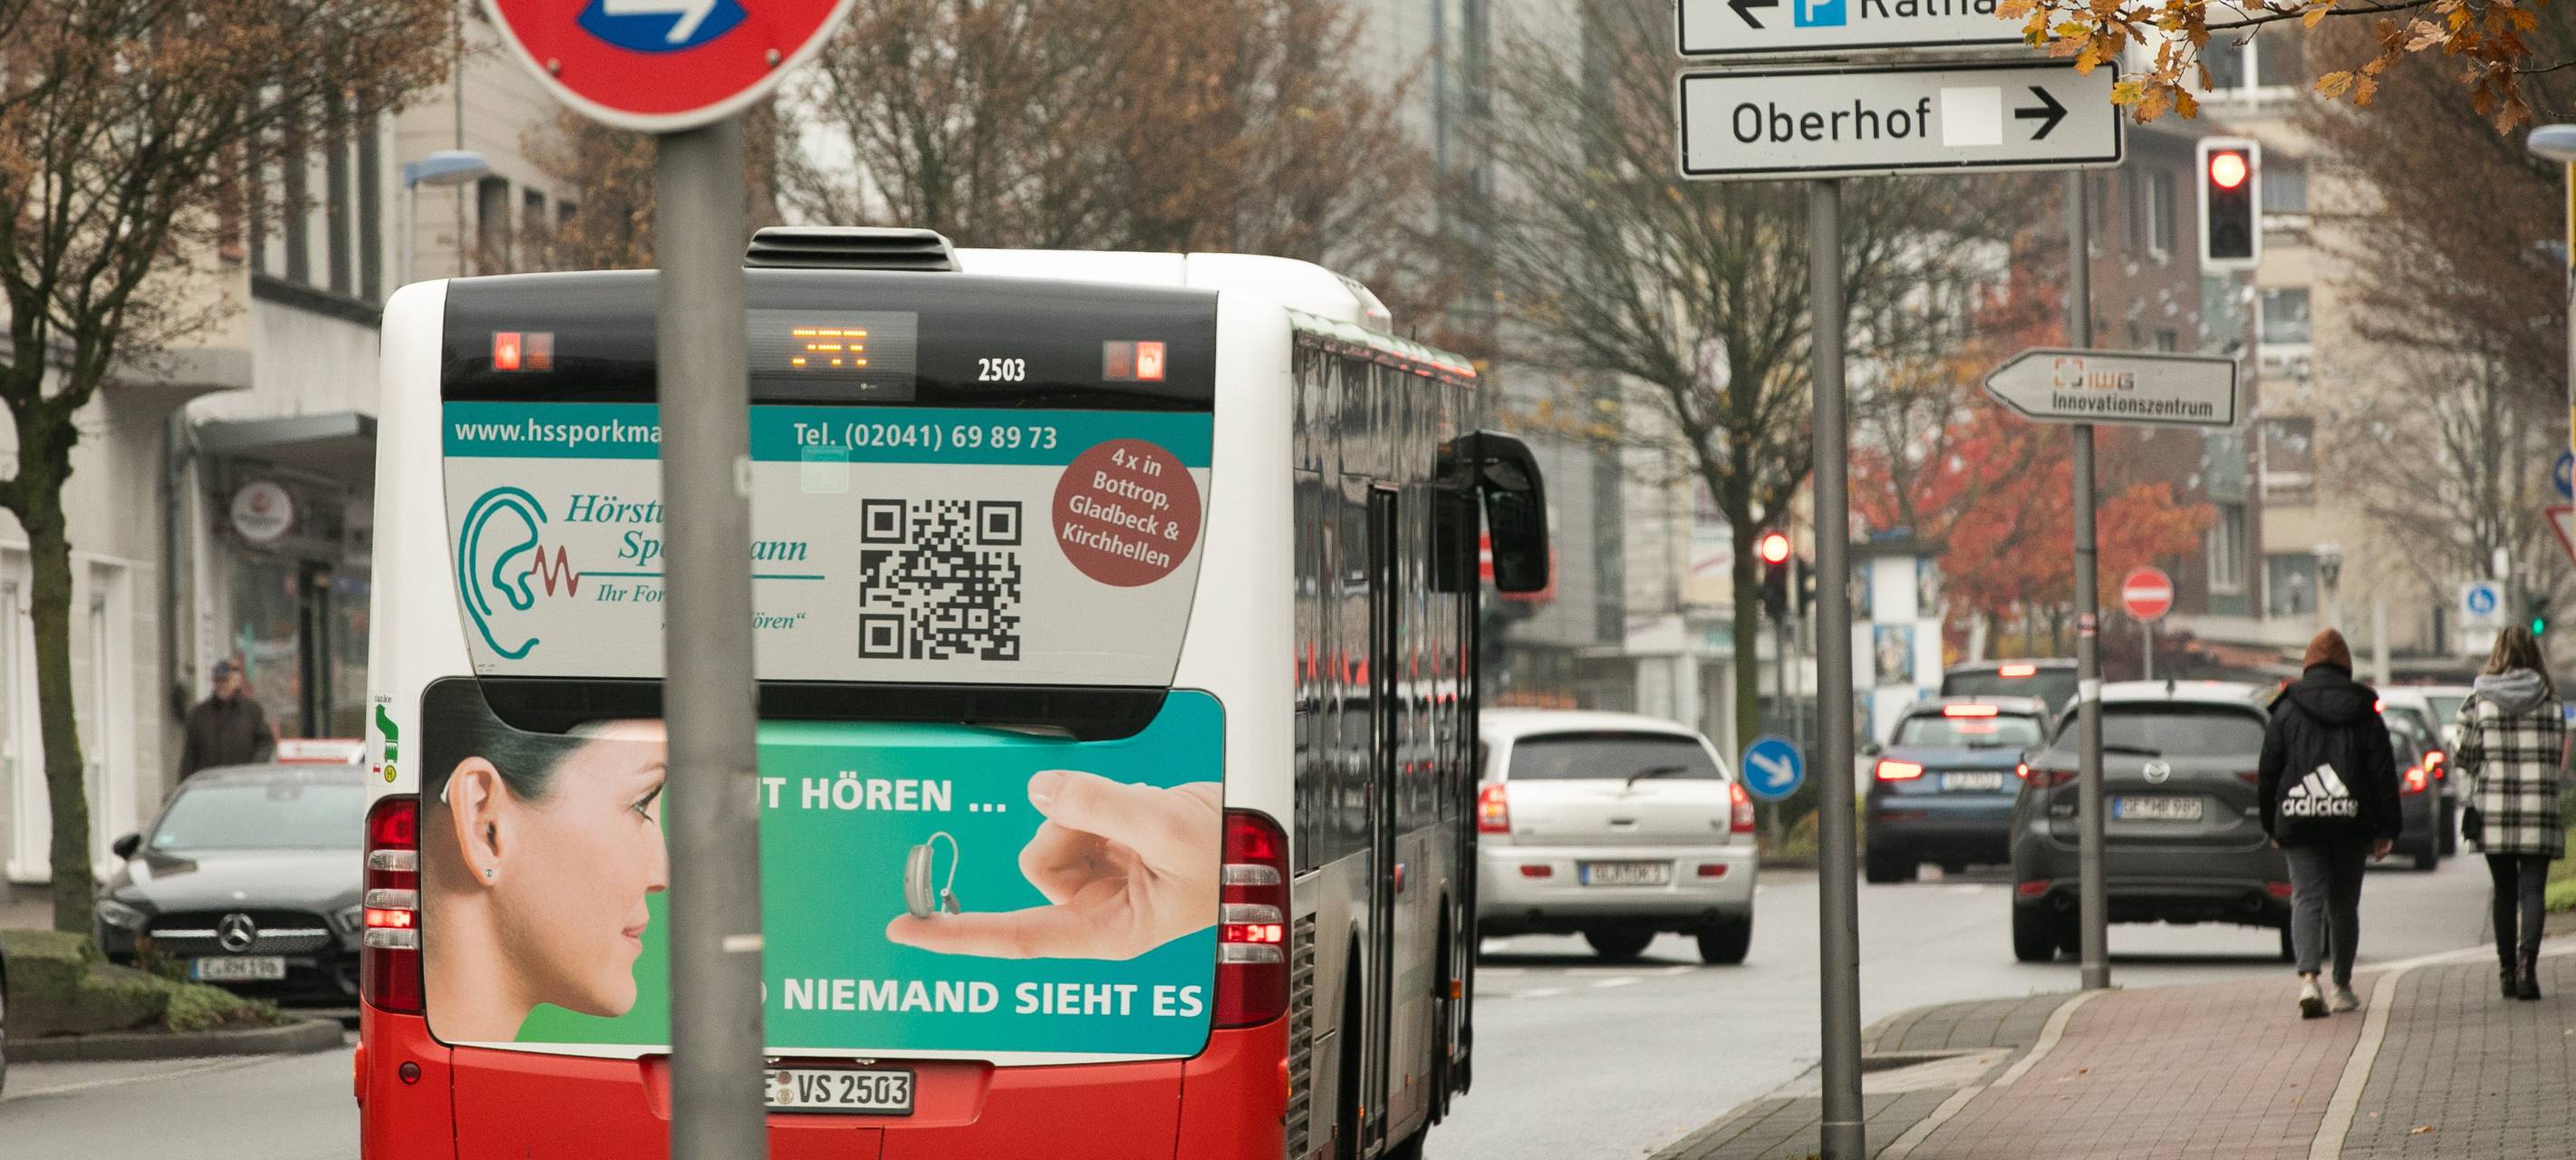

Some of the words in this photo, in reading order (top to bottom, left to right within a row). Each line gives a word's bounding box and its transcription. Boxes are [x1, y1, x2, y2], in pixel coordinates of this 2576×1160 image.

[1732, 96, 1932, 144] Oberhof
[977, 357, 1027, 382] 2503
[2052, 391, 2214, 417] Innovationszentrum
[455, 418, 663, 448] www.hssporkma
[794, 422, 836, 446] Tel.
[844, 422, 943, 451] (02041)
[951, 424, 983, 449] 69
[990, 425, 1021, 450] 89
[1028, 426, 1057, 450] 73
[1093, 470, 1170, 511] Bottrop,
[1069, 495, 1160, 536] Gladbeck
[1163, 521, 1180, 541] &
[1062, 521, 1171, 569] Kirchhellen
[595, 583, 627, 604] Ihr
[632, 584, 667, 604] For
[751, 611, 806, 630] ören“
[801, 770, 952, 812] HÖREN
[2282, 794, 2359, 817] adidas
[783, 977, 1000, 1014] NIEMAND
[1014, 981, 1139, 1017] SIEHT
[1153, 984, 1204, 1019] ES
[797, 1074, 832, 1104] VS
[839, 1075, 908, 1105] 2503
